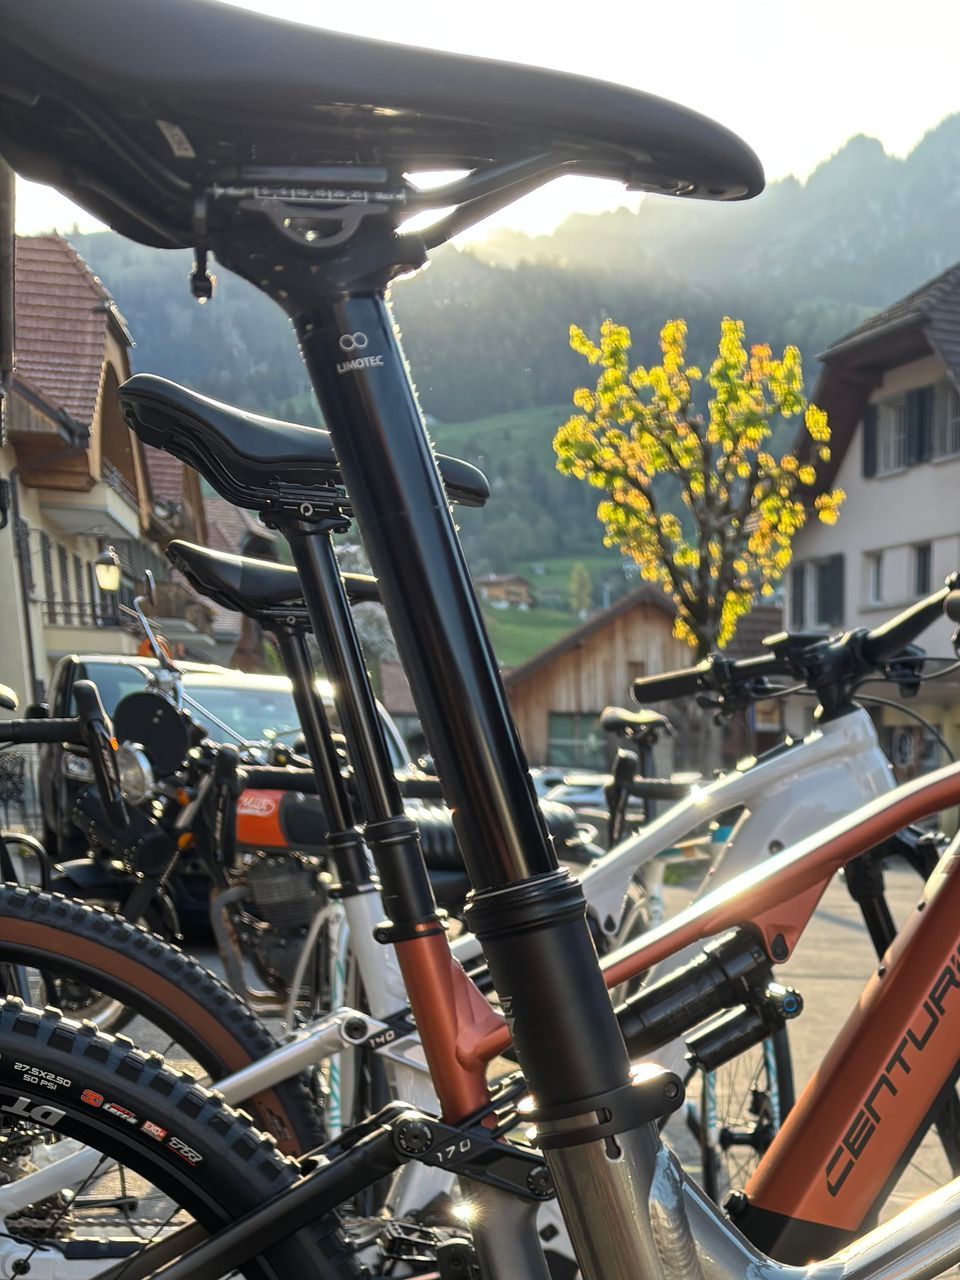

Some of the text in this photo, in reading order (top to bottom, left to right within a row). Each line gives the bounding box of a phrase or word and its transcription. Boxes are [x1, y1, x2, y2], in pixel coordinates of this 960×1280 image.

[337, 355, 384, 374] LIMOTEC
[369, 1030, 395, 1048] 140
[14, 1062, 72, 1087] 27.5X2.50
[23, 1074, 58, 1091] 50 PSI
[436, 1138, 471, 1163] 170
